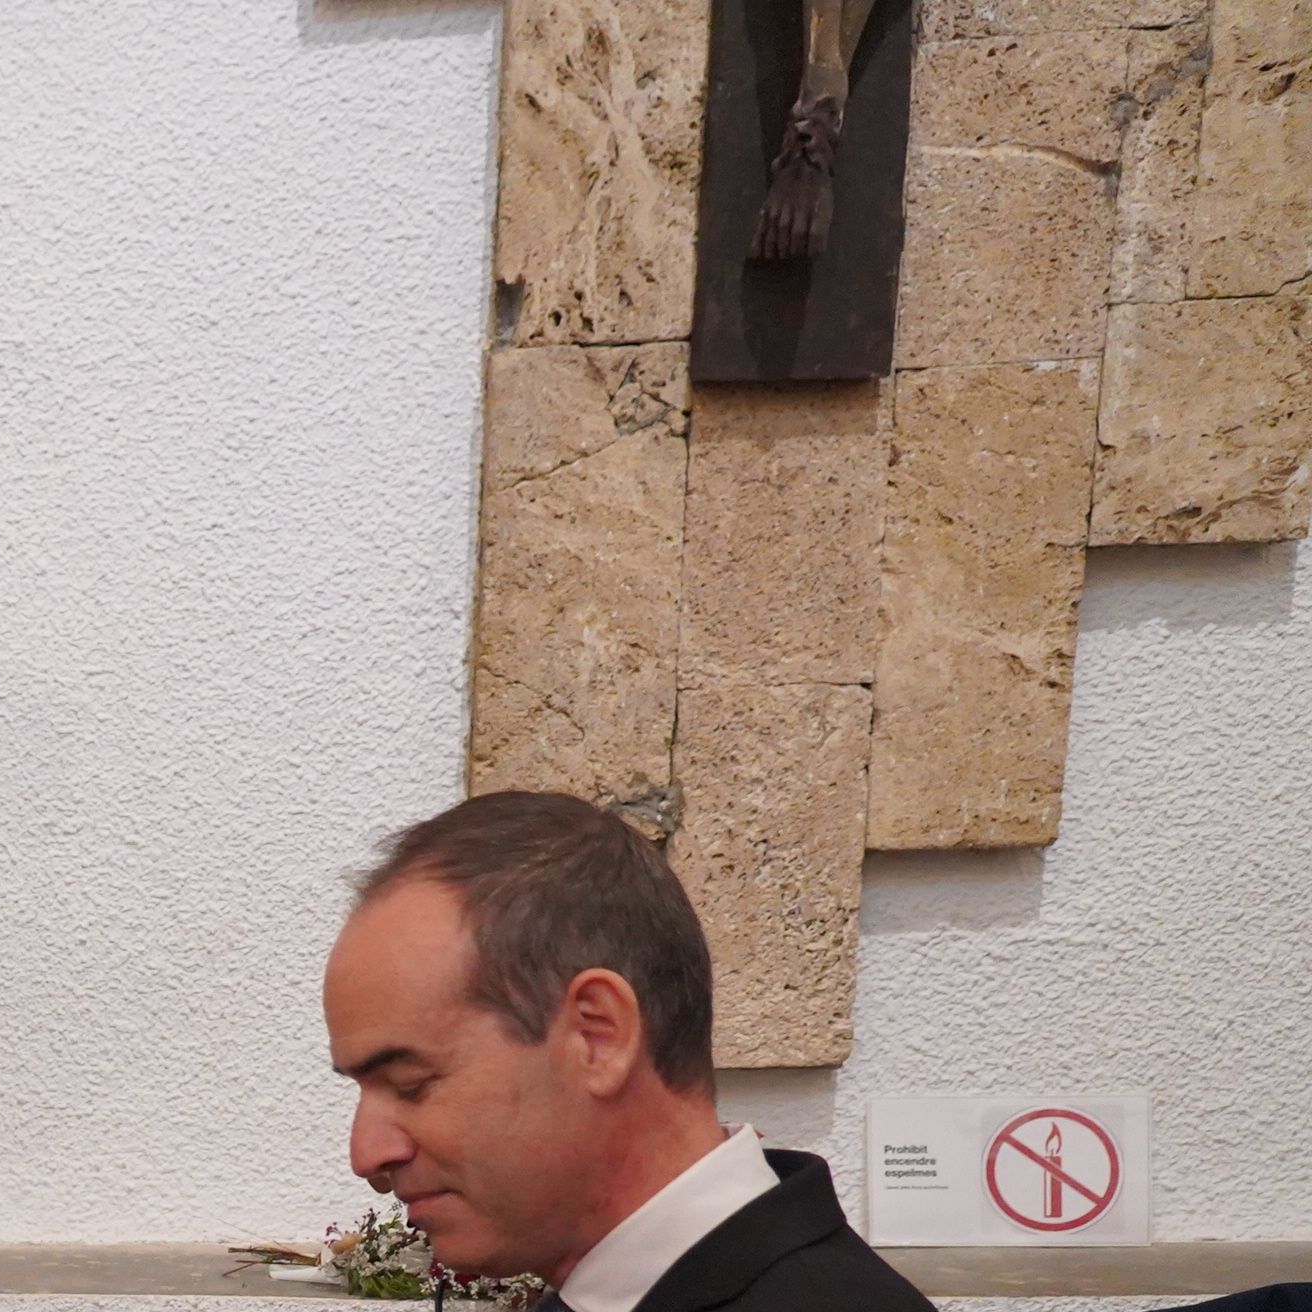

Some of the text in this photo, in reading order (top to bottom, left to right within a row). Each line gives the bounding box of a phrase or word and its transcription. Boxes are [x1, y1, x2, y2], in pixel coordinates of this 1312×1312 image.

[884, 1144, 928, 1154] Prohibit
[884, 1157, 937, 1166] encendre
[884, 1168, 938, 1179] espelmes
